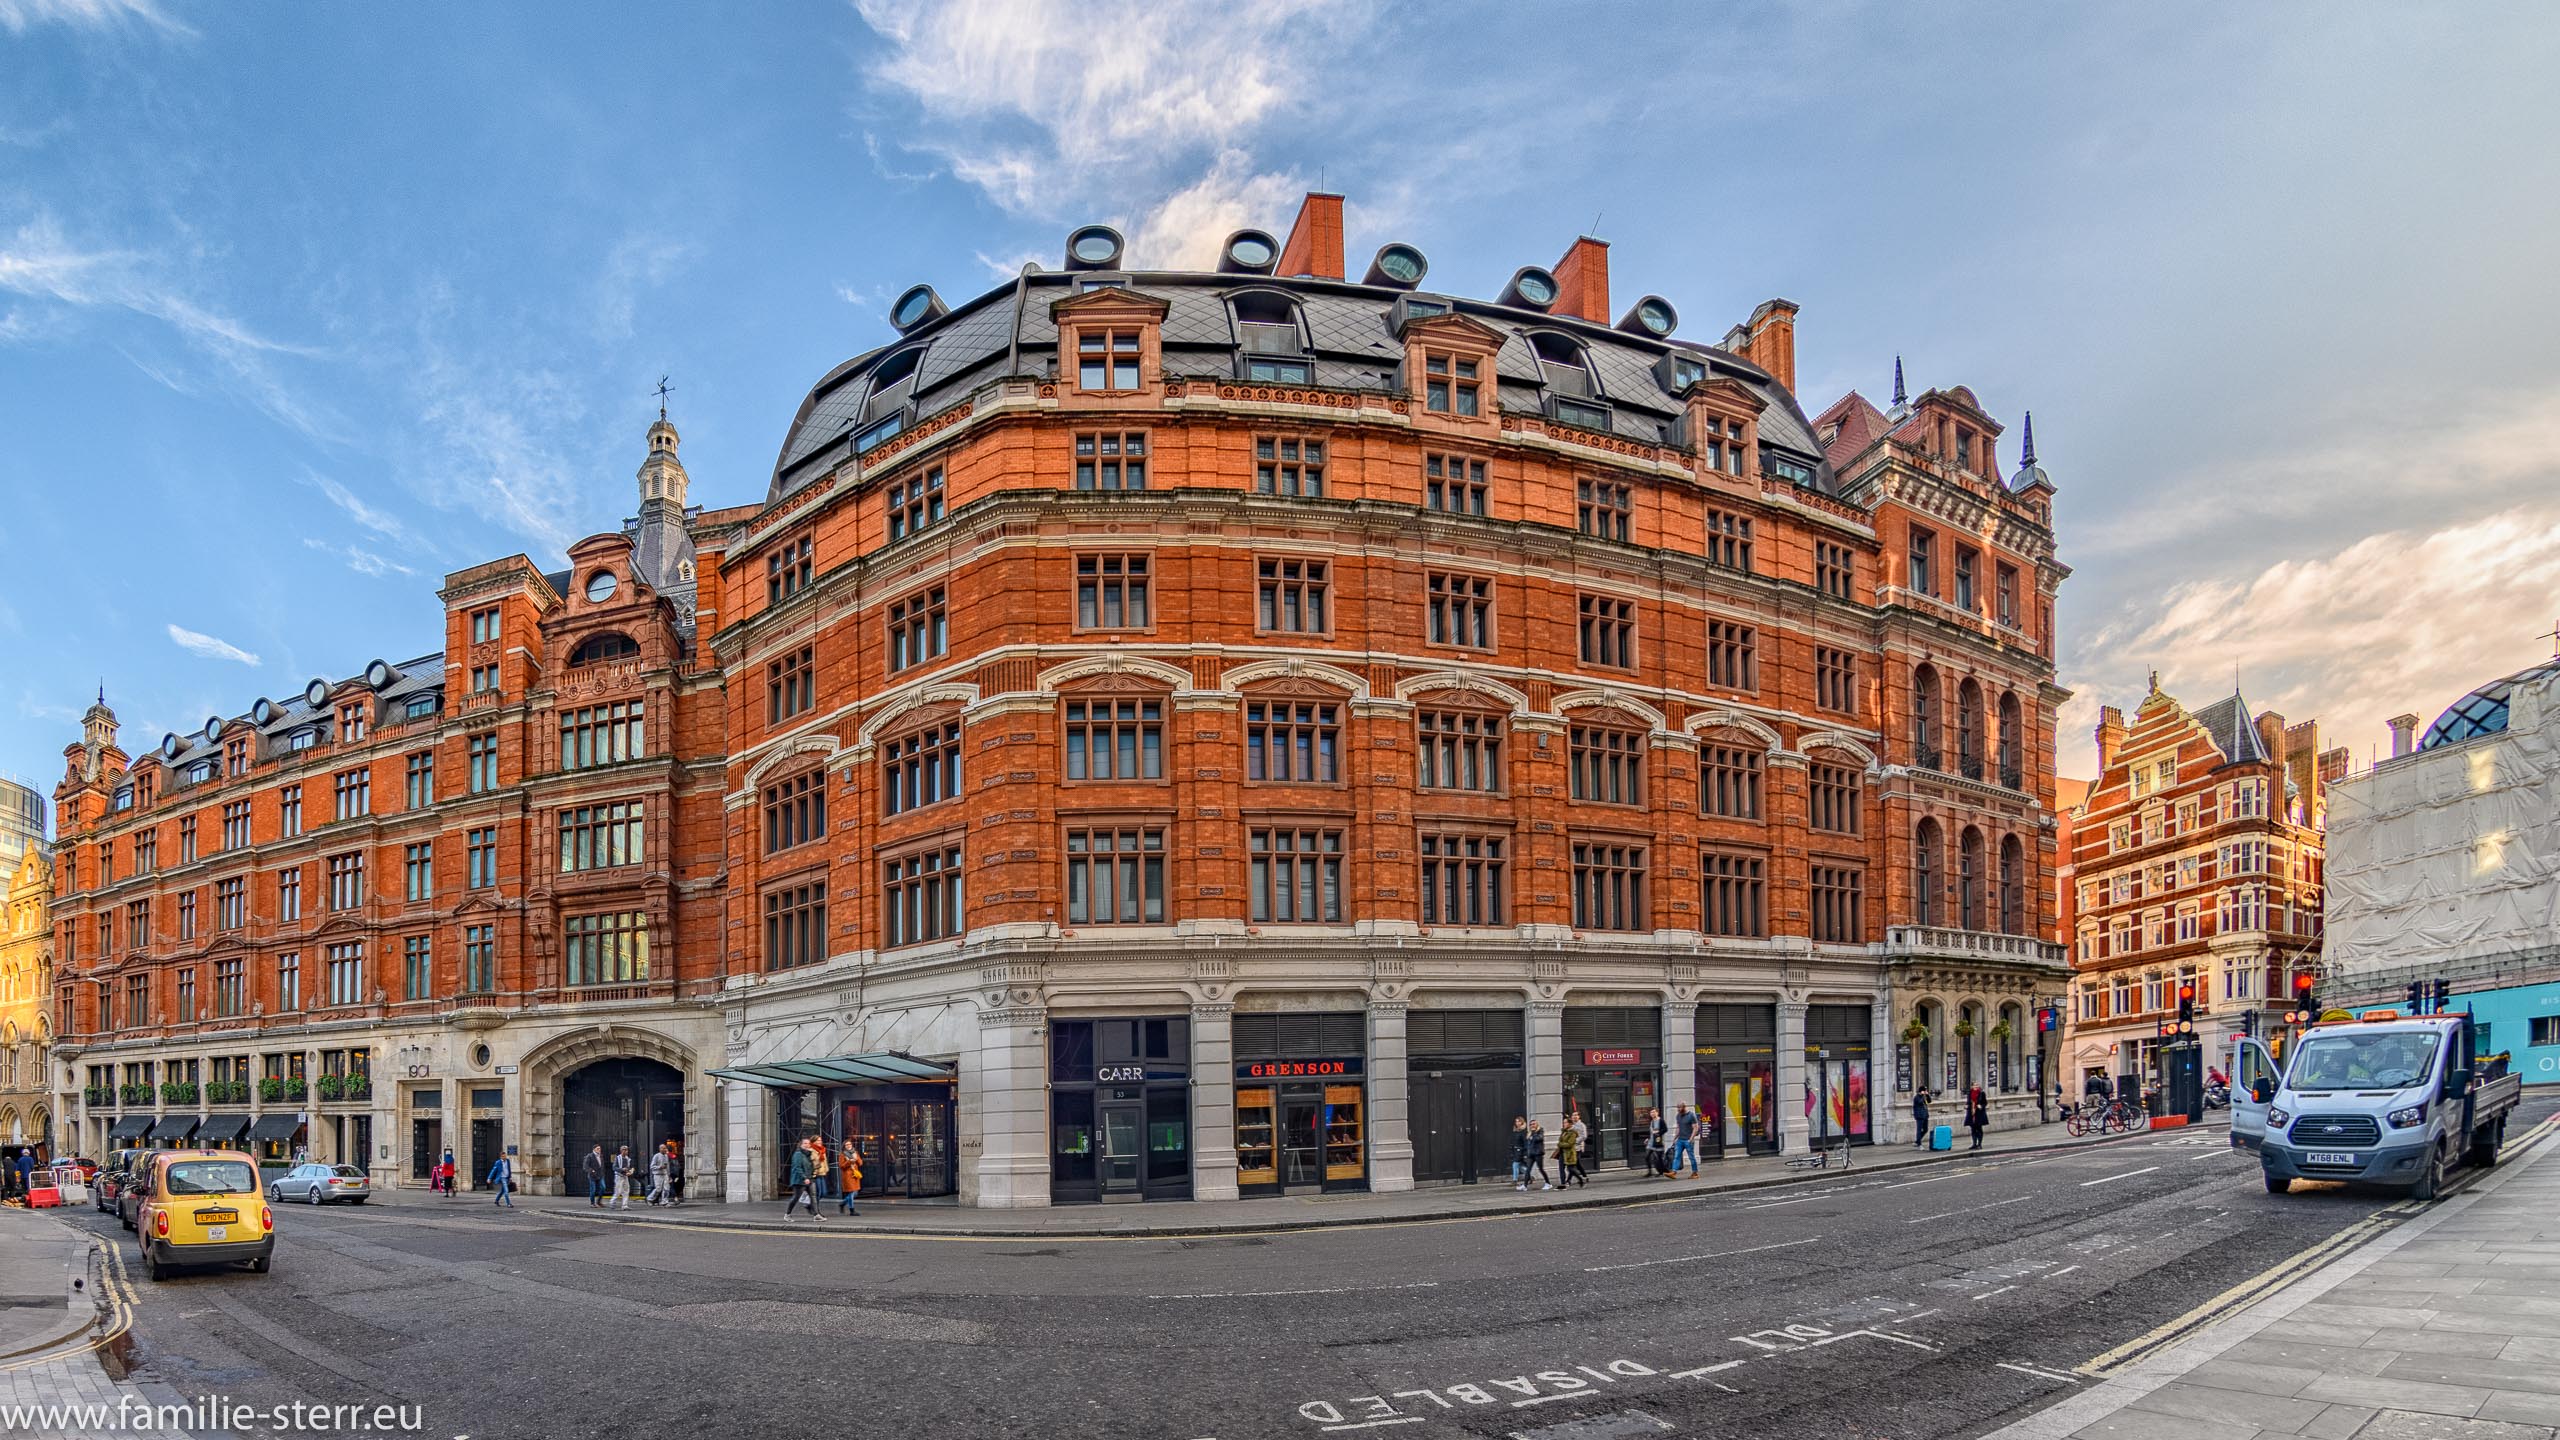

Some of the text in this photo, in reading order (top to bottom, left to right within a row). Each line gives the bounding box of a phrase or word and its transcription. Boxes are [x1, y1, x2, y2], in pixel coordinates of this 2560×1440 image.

[1251, 1062, 1345, 1076] GRENSON
[2539, 1057, 2560, 1071] O
[1098, 1067, 1144, 1081] CARR
[2310, 1154, 2350, 1162] MT68 ENL
[1299, 1358, 1656, 1422] DISABLED
